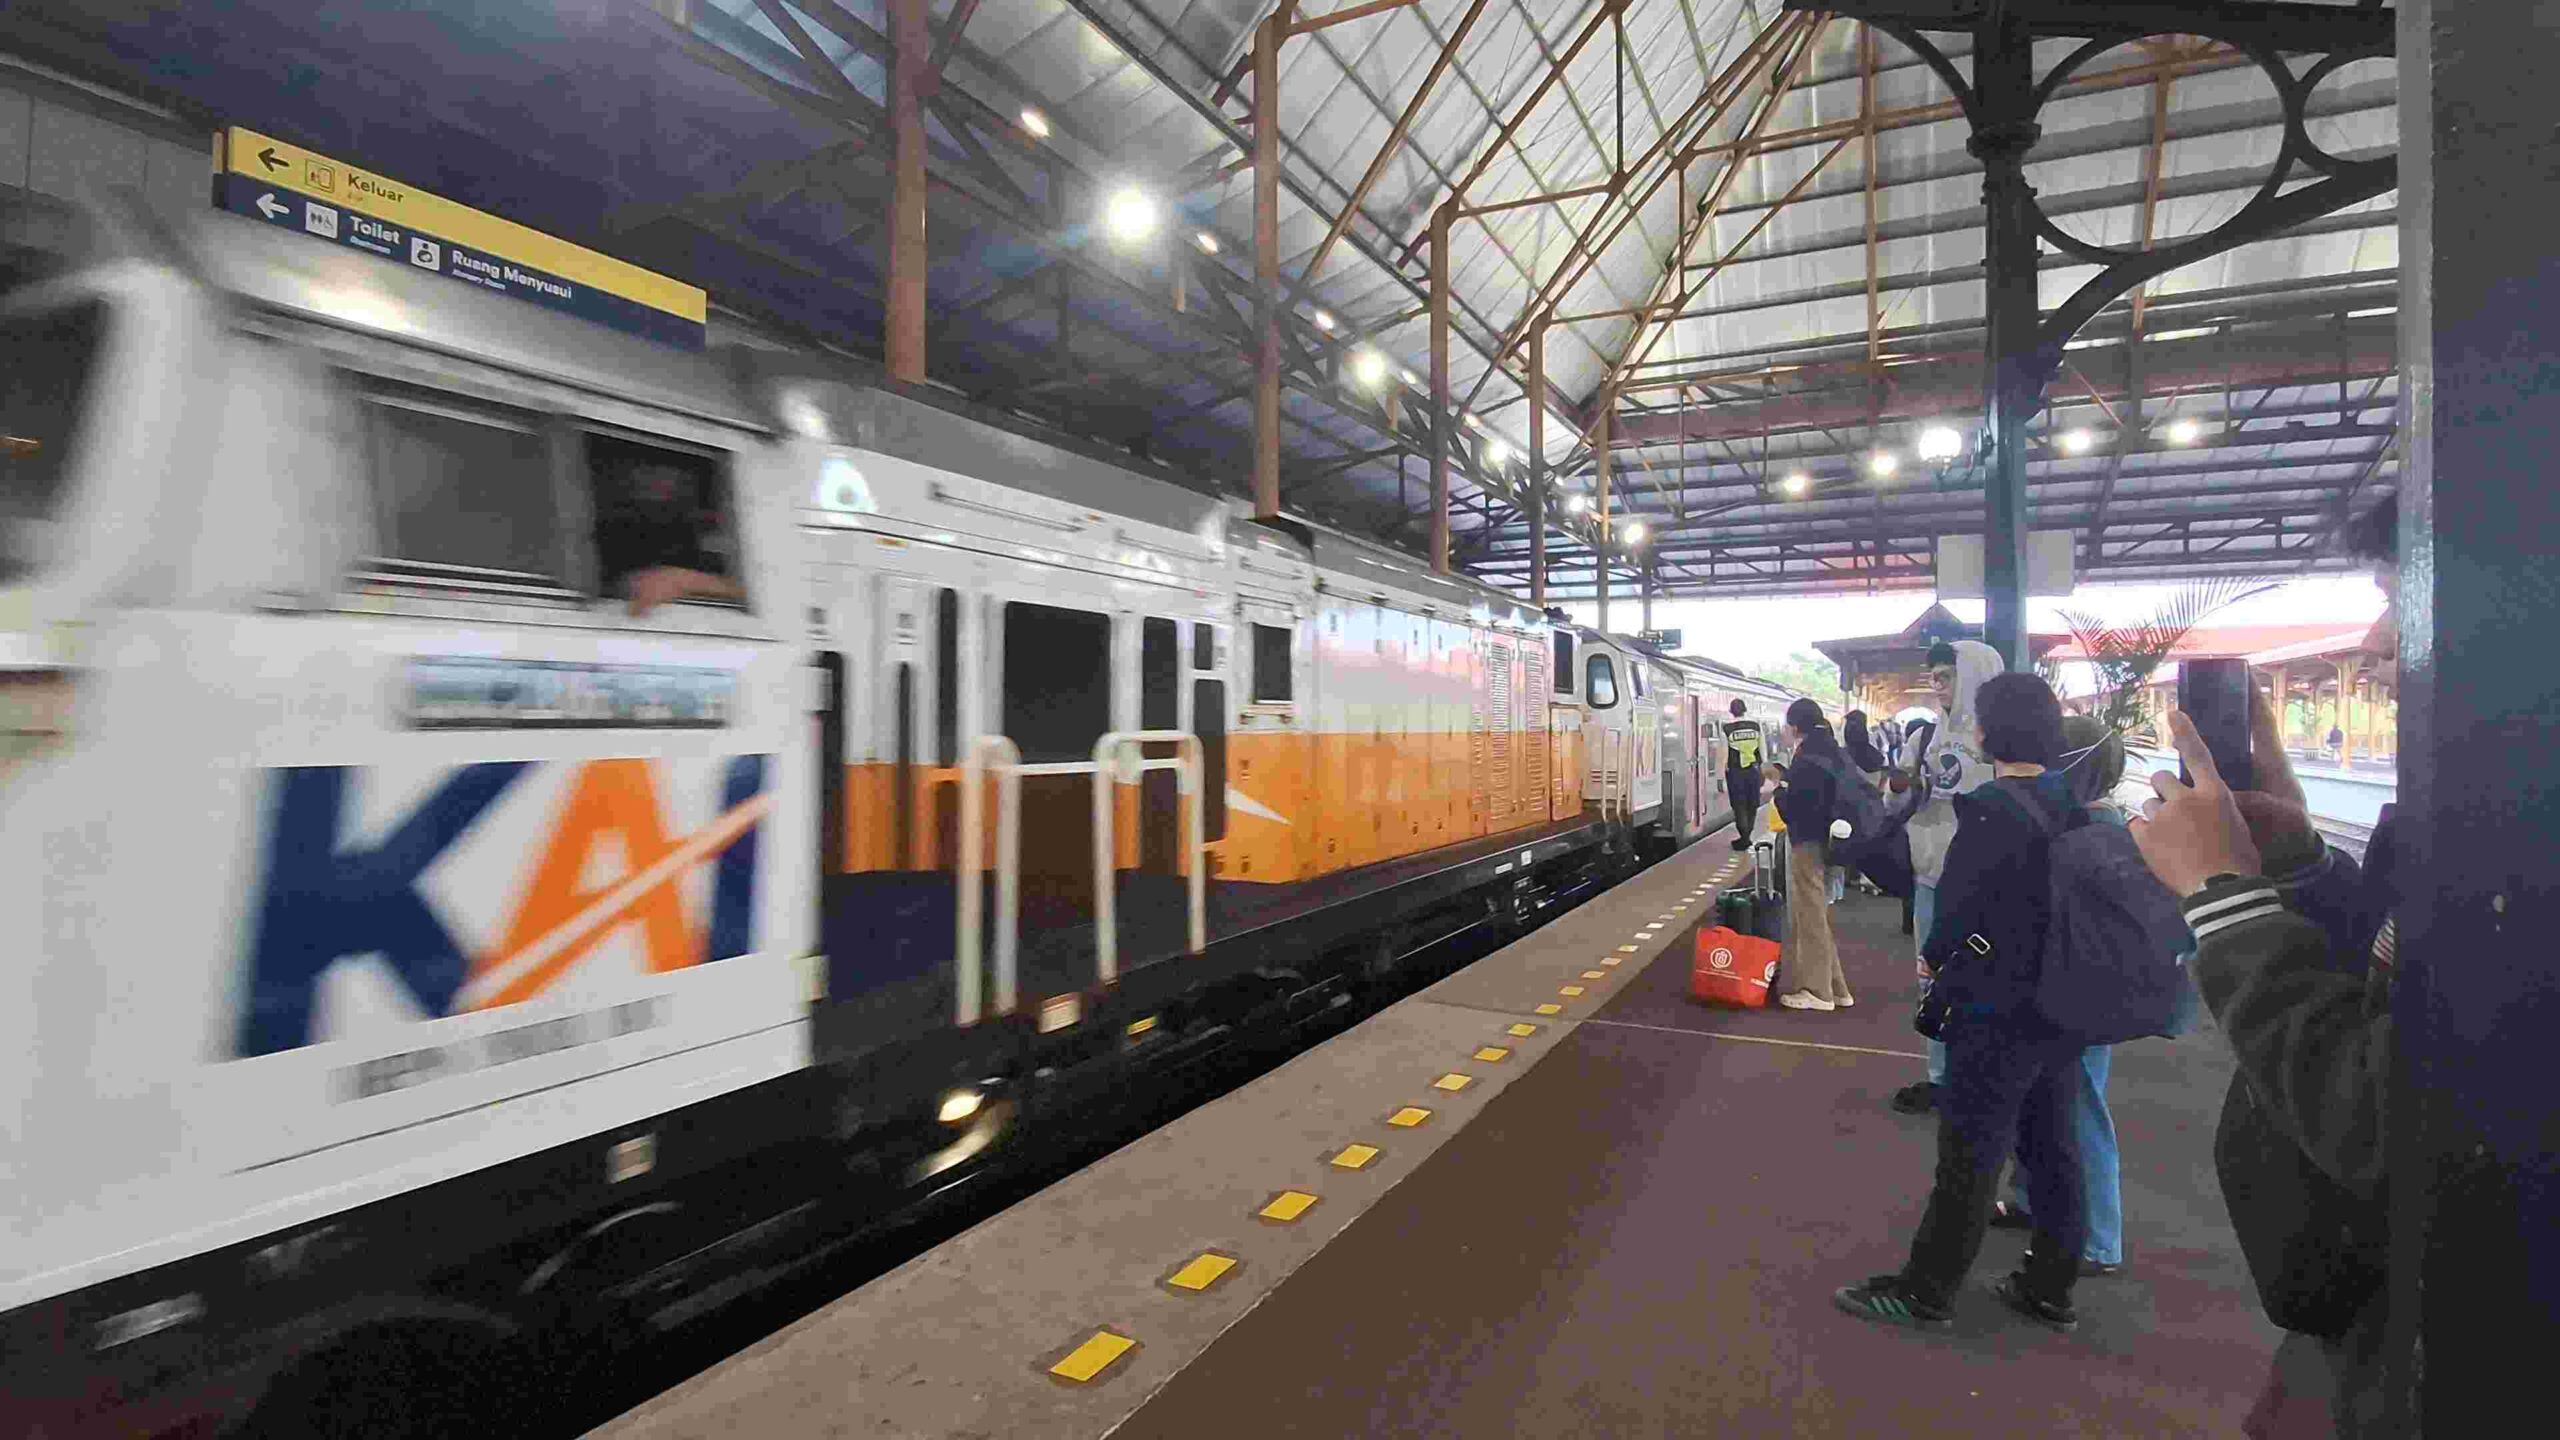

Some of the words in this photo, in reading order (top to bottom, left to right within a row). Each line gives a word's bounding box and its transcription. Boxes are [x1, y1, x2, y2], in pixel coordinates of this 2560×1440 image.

[348, 173, 405, 203] Keluar
[350, 215, 401, 245] Toilet
[452, 249, 500, 280] Ruang
[504, 266, 572, 299] Menyusui
[232, 753, 776, 1060] KAI
